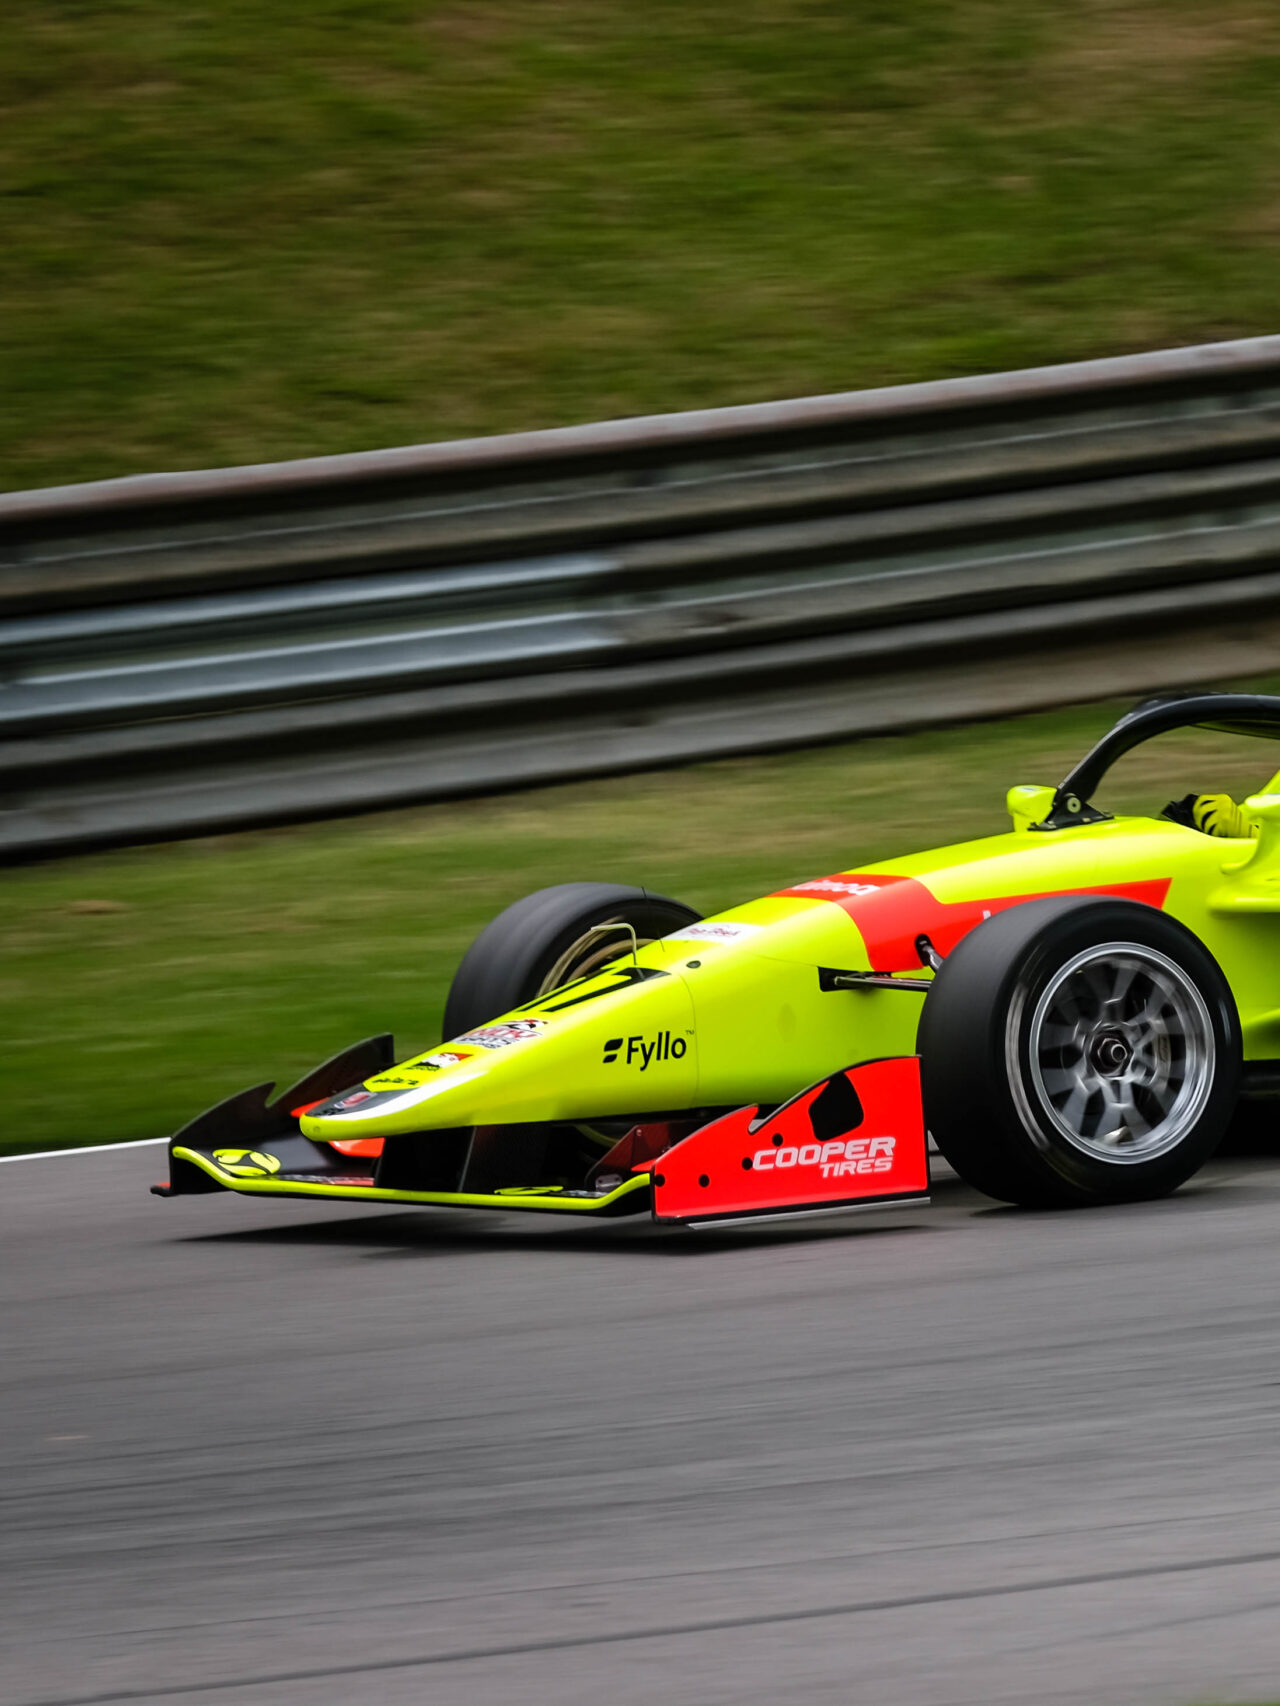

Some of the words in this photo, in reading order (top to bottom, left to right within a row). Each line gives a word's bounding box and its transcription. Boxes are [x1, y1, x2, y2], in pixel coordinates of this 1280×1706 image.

[626, 1030, 687, 1072] Fyllo
[752, 1136, 896, 1171] COOPER
[819, 1157, 894, 1179] TIRES
